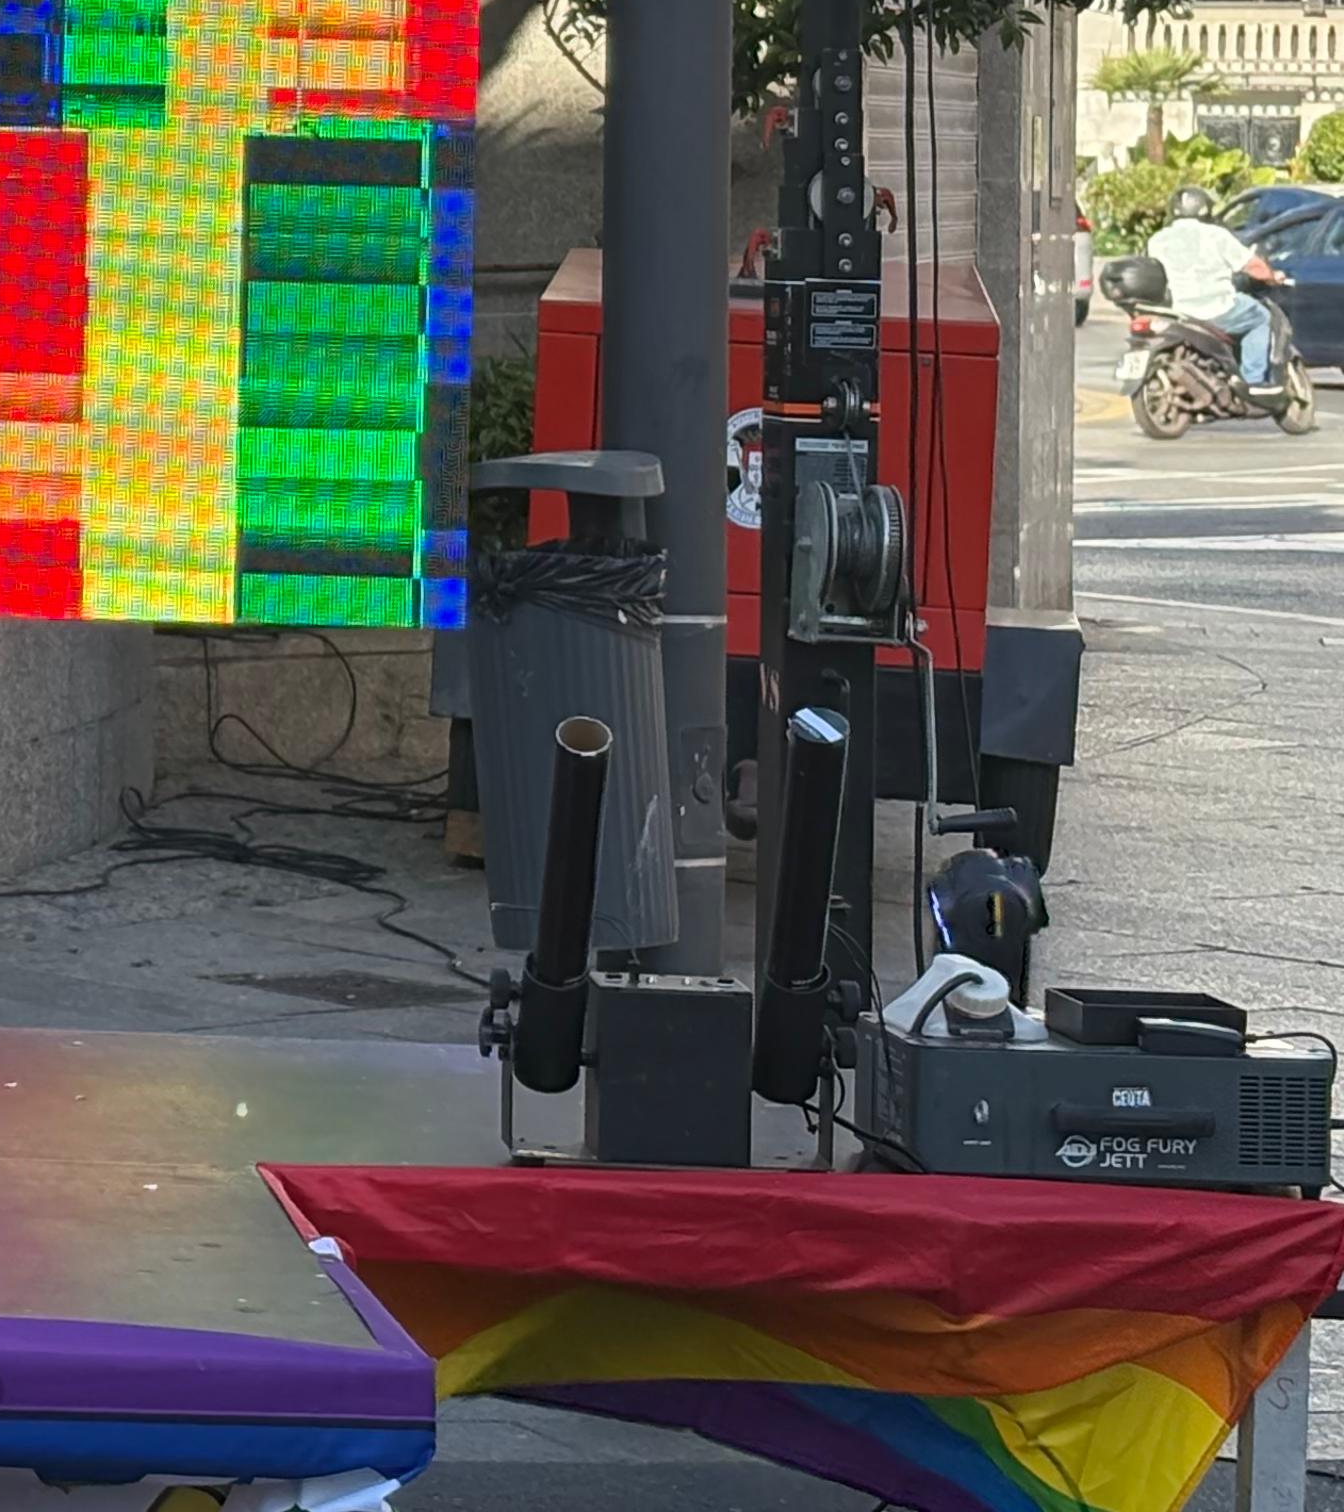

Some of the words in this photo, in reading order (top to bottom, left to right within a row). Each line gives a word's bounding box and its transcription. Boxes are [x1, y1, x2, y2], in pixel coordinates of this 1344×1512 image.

[1099, 1137, 1141, 1153] FOG
[1147, 1139, 1197, 1156] FURY
[1099, 1153, 1148, 1169] JETT
